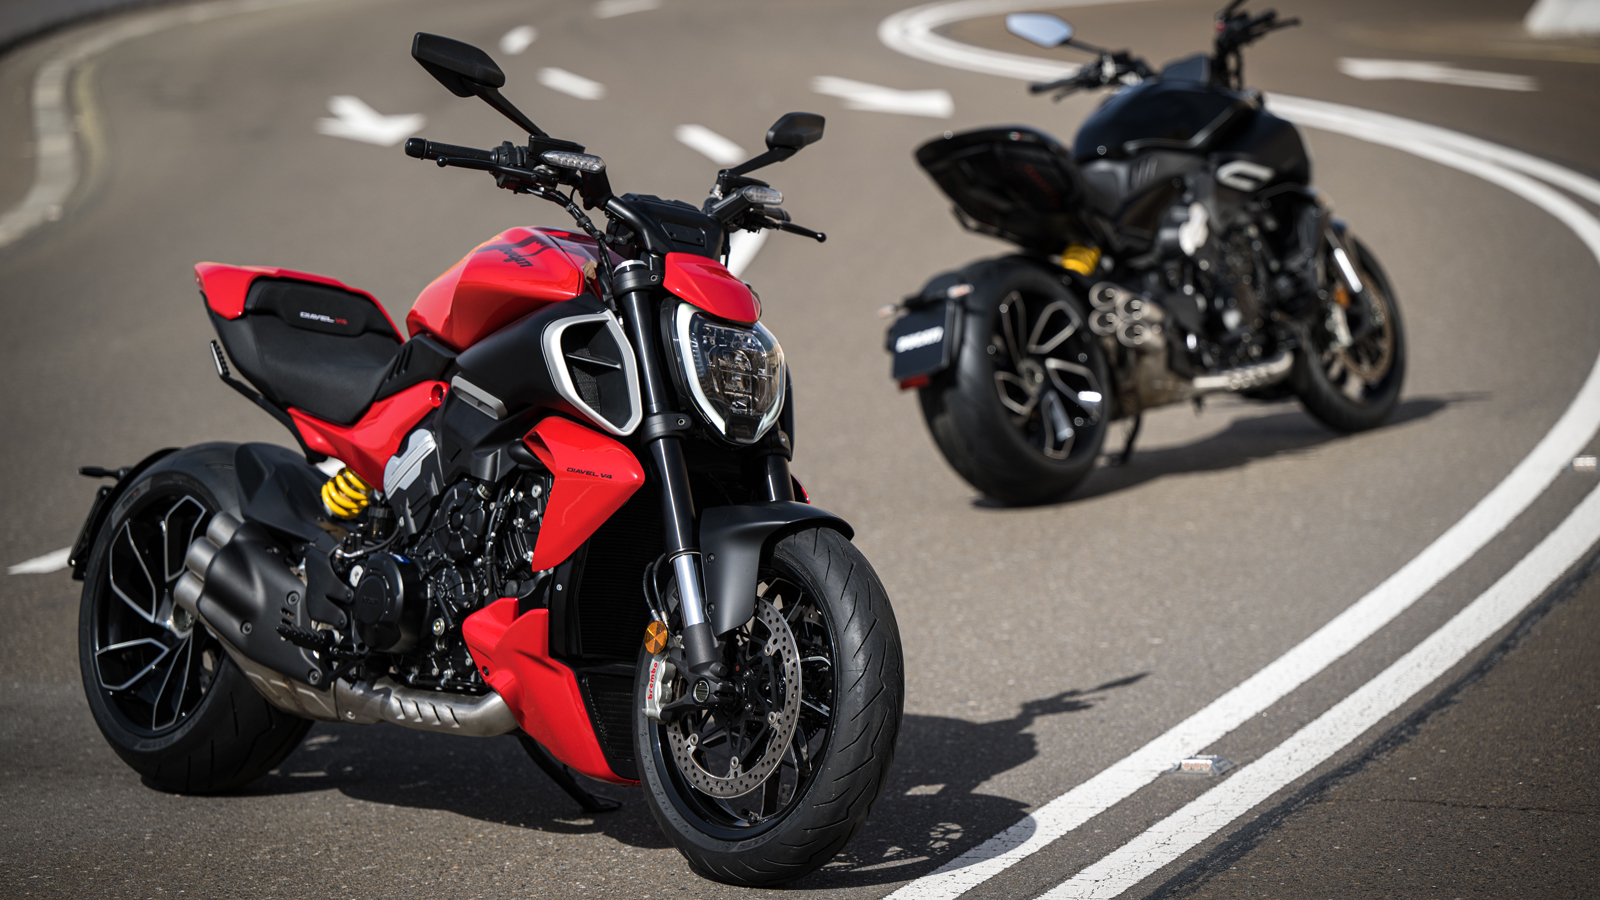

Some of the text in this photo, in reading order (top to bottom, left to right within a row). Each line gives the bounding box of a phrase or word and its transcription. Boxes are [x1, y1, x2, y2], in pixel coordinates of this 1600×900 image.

[300, 311, 335, 323] DIAVEL
[566, 467, 599, 477] DIAVEL
[647, 662, 658, 700] brembo
